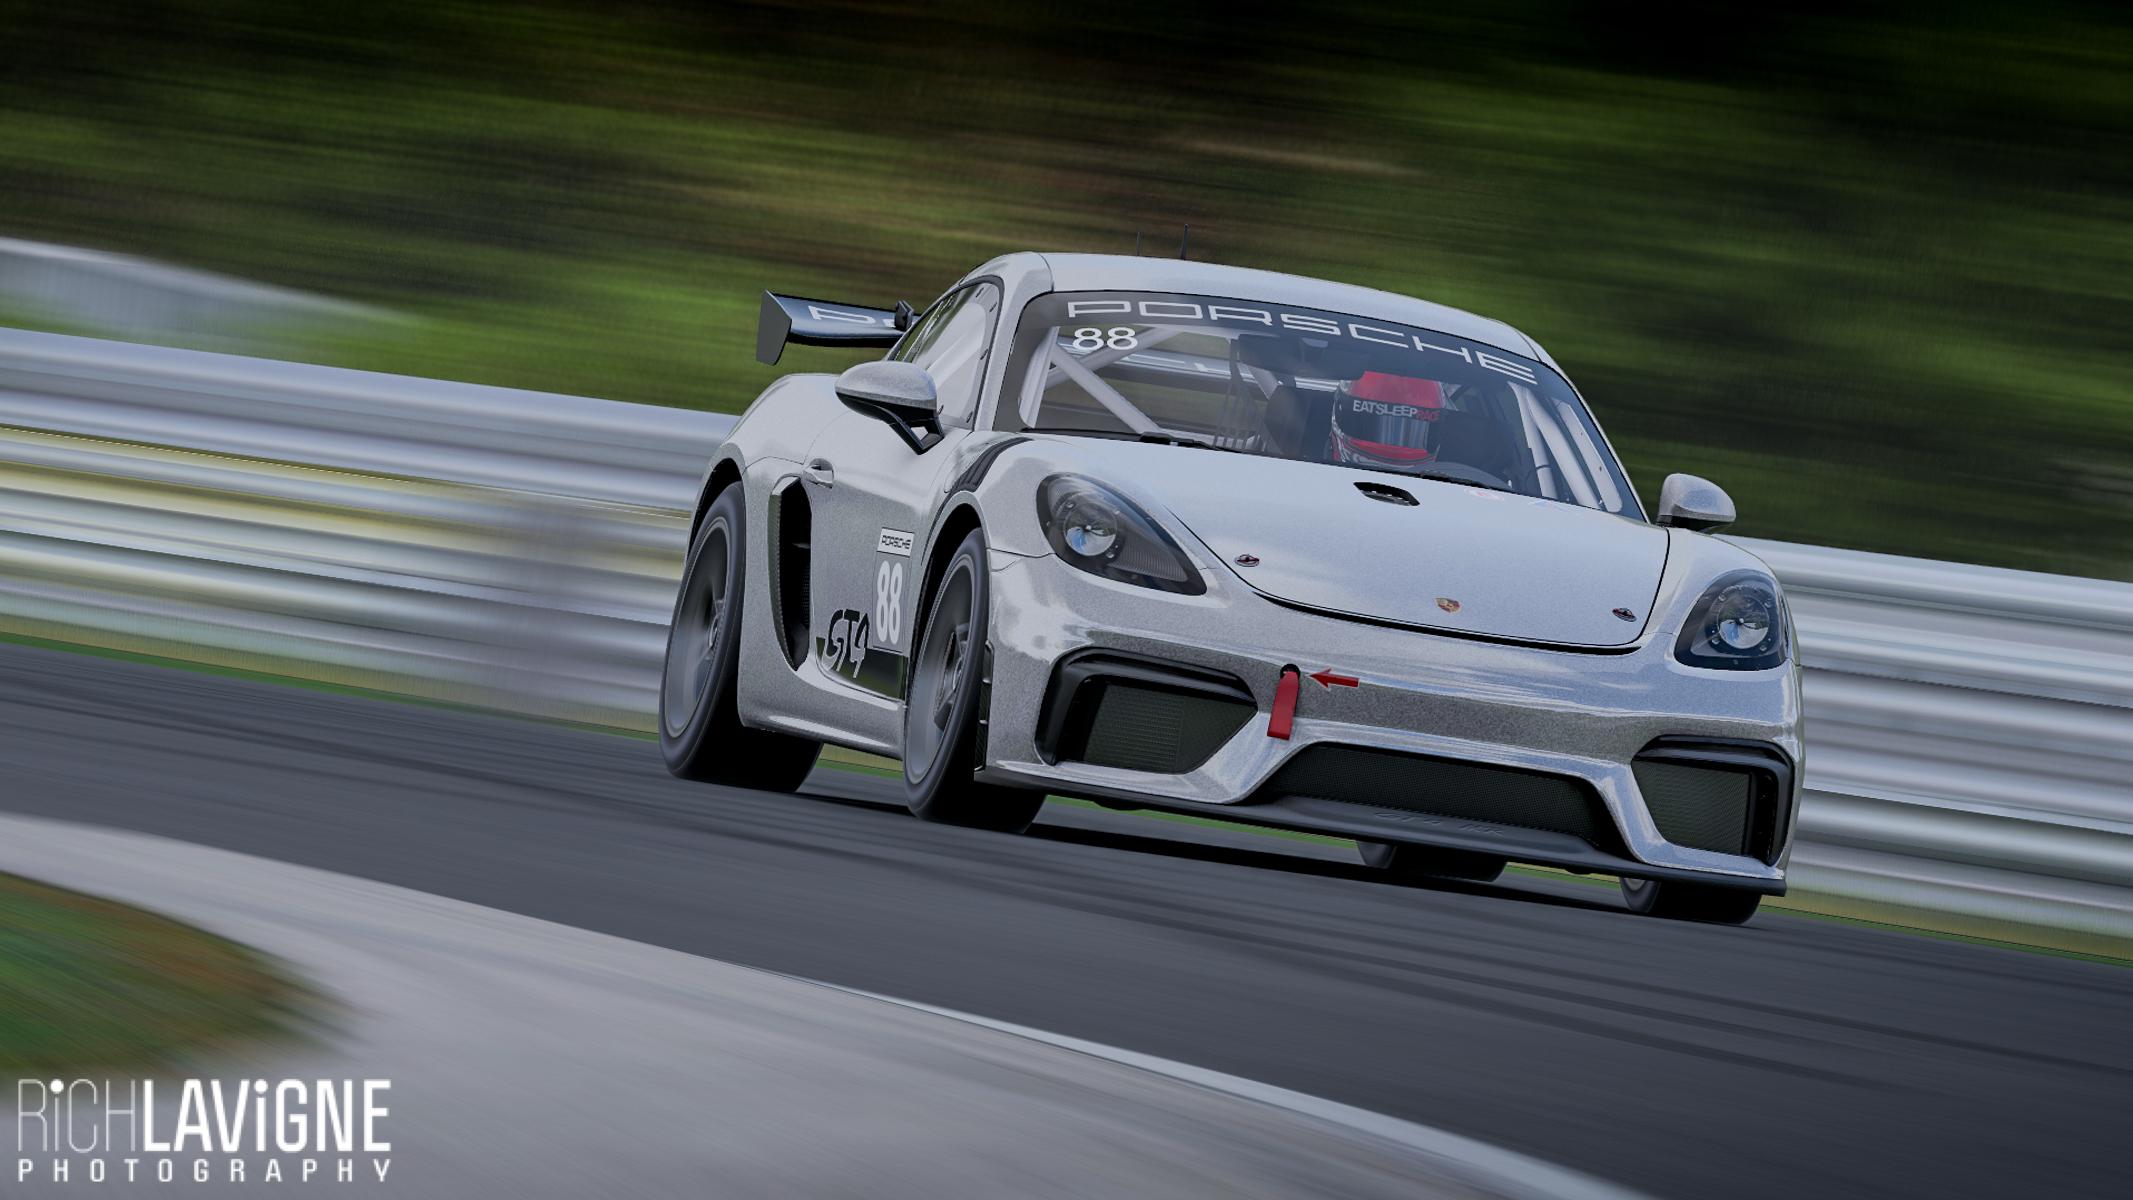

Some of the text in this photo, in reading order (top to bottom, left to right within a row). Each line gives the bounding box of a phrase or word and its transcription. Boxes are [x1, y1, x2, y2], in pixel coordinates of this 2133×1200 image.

[1067, 300, 1537, 385] PORSCHE
[1072, 327, 1138, 351] 88
[882, 535, 911, 549] PORSCHE
[877, 561, 903, 644] 88
[823, 609, 870, 678] GT4
